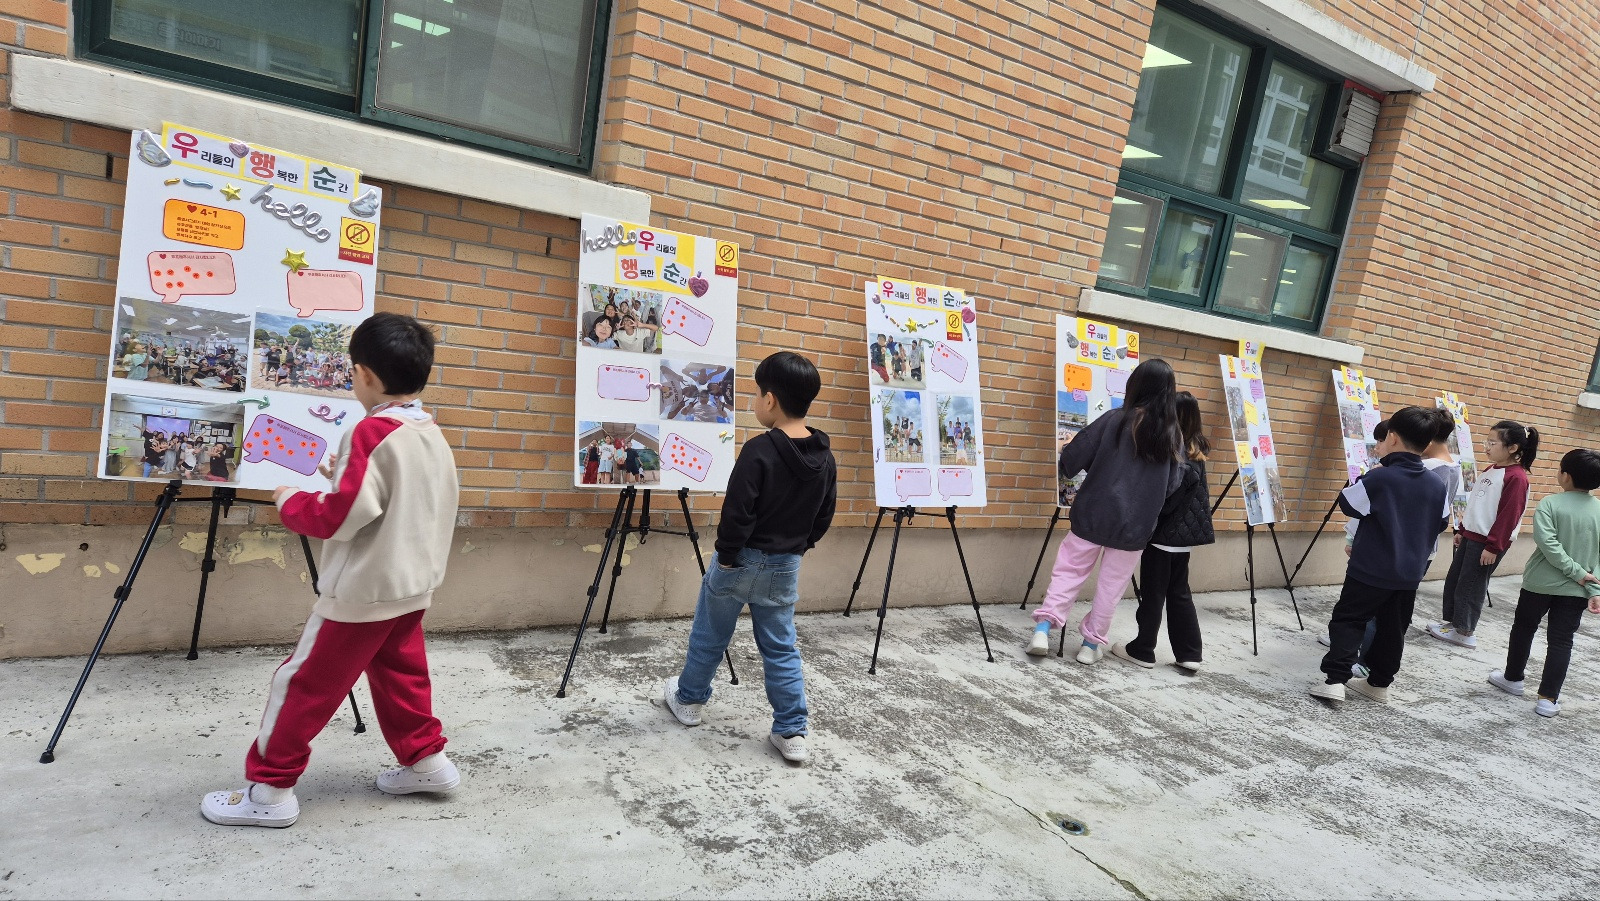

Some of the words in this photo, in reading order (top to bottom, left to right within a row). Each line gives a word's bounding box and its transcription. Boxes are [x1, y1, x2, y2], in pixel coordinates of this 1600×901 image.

[171, 132, 235, 168] 우리들의
[250, 151, 298, 183] 행복한
[313, 166, 348, 193] 순간
[200, 208, 218, 218] 4-1
[250, 183, 331, 243] hello
[581, 223, 638, 253] hello
[638, 230, 676, 255] 우리들의
[620, 258, 655, 280] 행복한
[663, 262, 687, 286] 순간
[882, 280, 910, 300] 우리들의
[915, 286, 938, 305] 행복한
[943, 290, 961, 307] 순간
